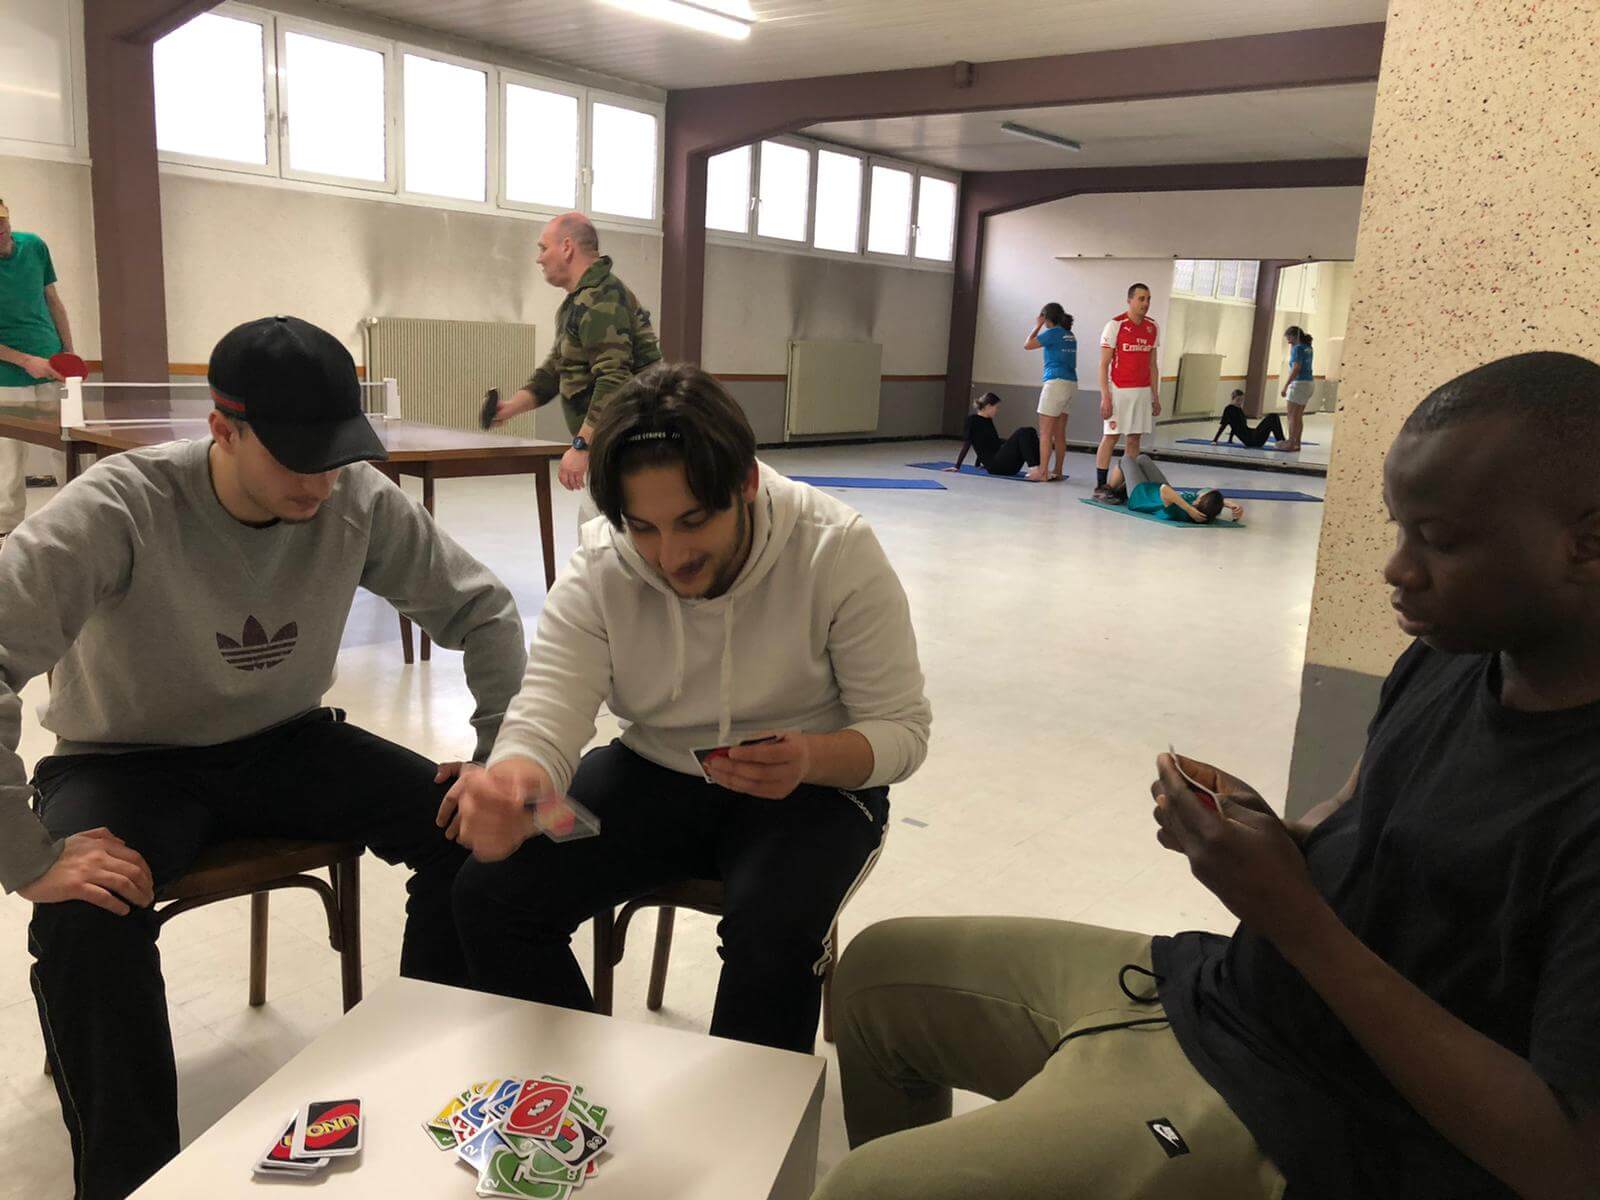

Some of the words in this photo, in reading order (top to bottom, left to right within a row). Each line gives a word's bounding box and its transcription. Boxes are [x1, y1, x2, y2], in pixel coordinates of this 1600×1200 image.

[1122, 343, 1153, 352] Emirate
[306, 1113, 359, 1137] UNO
[464, 1145, 478, 1156] 2
[485, 1179, 500, 1188] 2
